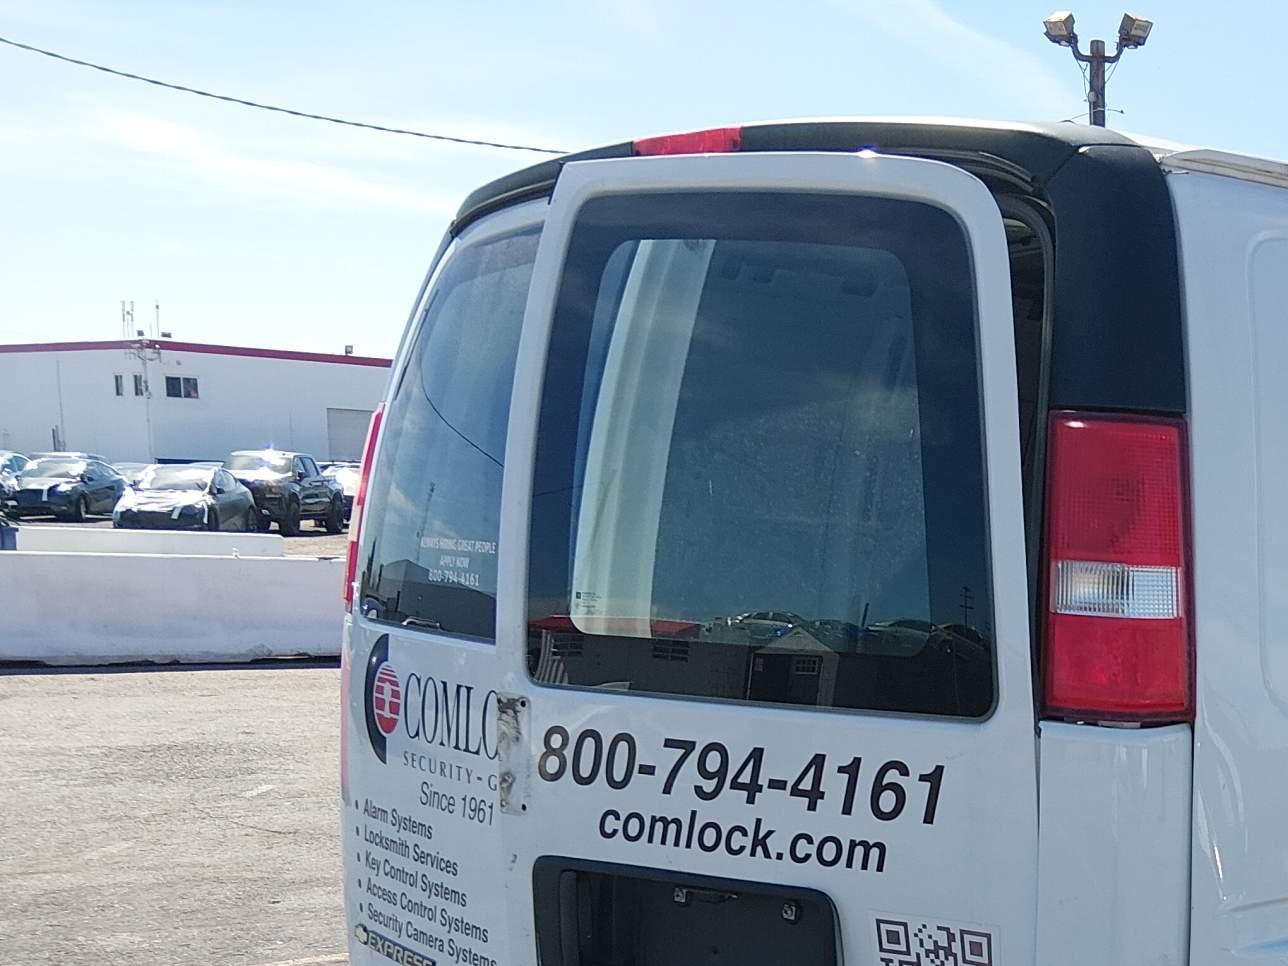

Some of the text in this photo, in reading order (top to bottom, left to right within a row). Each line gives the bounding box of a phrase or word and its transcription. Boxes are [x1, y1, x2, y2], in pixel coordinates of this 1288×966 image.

[537, 725, 946, 825] 800-794-4161
[363, 798, 433, 840] Alarm Systems
[419, 781, 494, 826] Since 1961
[363, 824, 459, 877] Locksmith Services
[599, 807, 888, 873] comlock.com
[365, 851, 468, 907] Key Control Systems
[366, 877, 489, 944] Access Control Systems
[367, 902, 404, 938] Security
[405, 921, 445, 953] Camera
